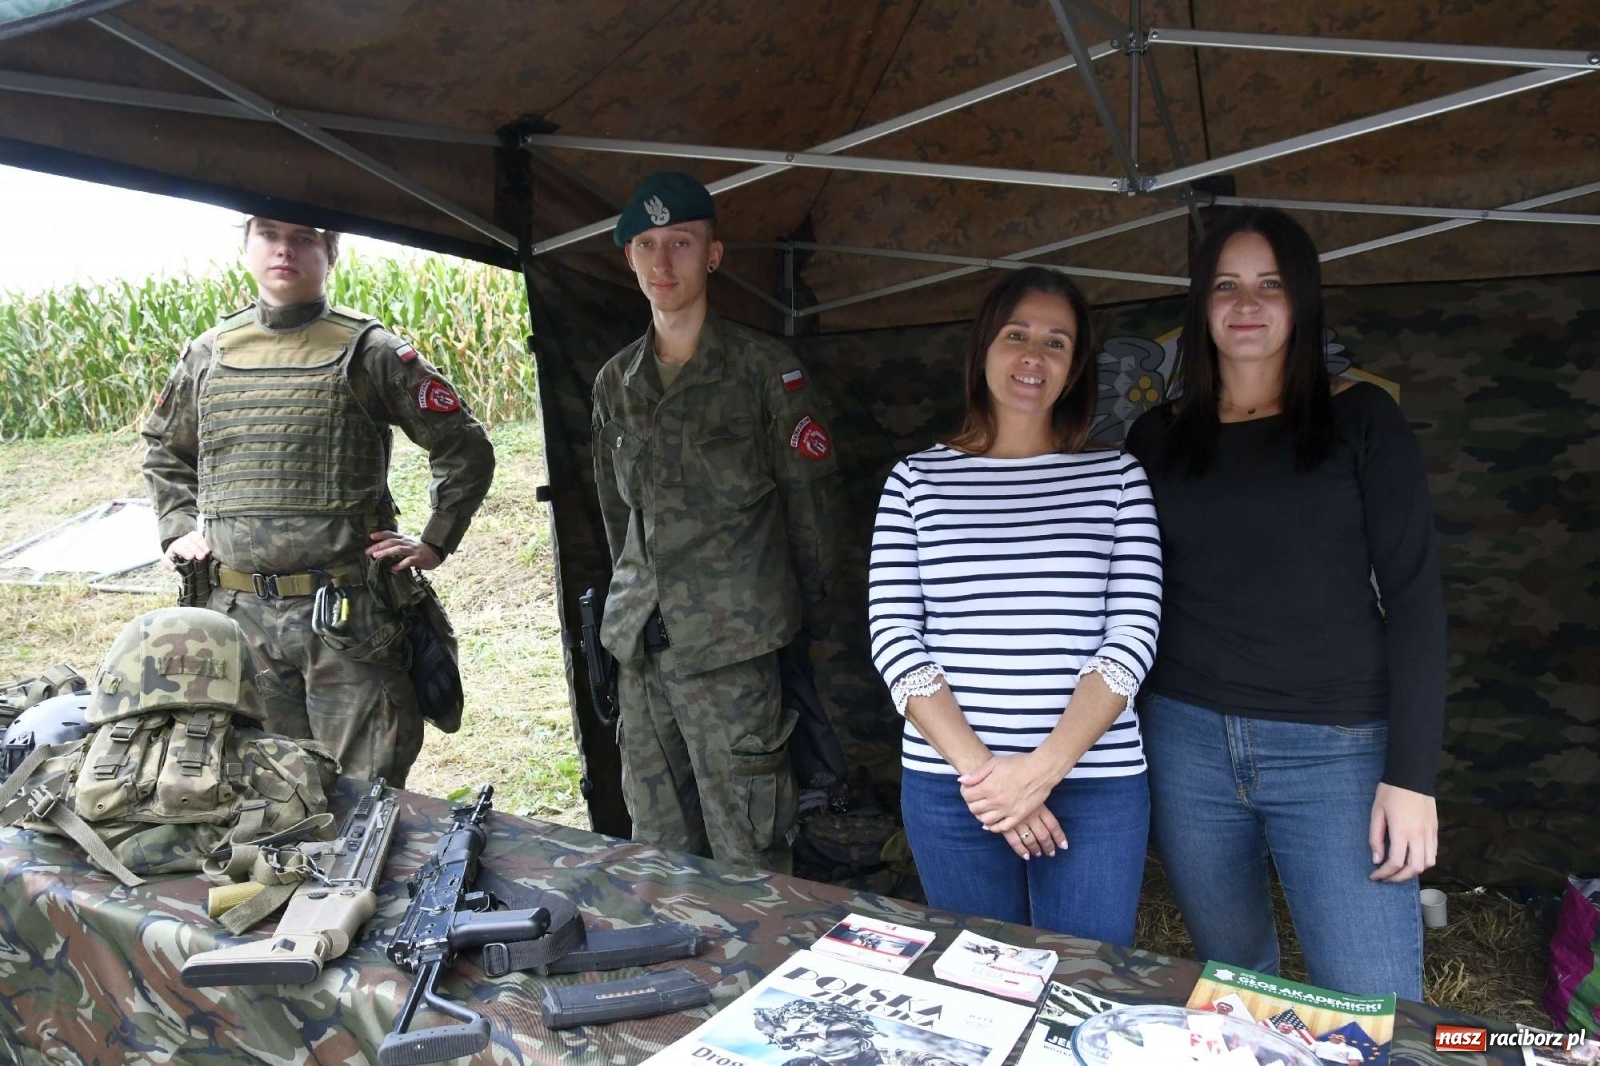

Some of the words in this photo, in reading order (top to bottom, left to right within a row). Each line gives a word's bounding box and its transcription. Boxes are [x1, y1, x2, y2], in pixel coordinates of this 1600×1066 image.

[783, 967, 943, 1020] POLSKA
[1239, 976, 1277, 991] GŁOS
[1279, 987, 1382, 1010] AKADEMICKI
